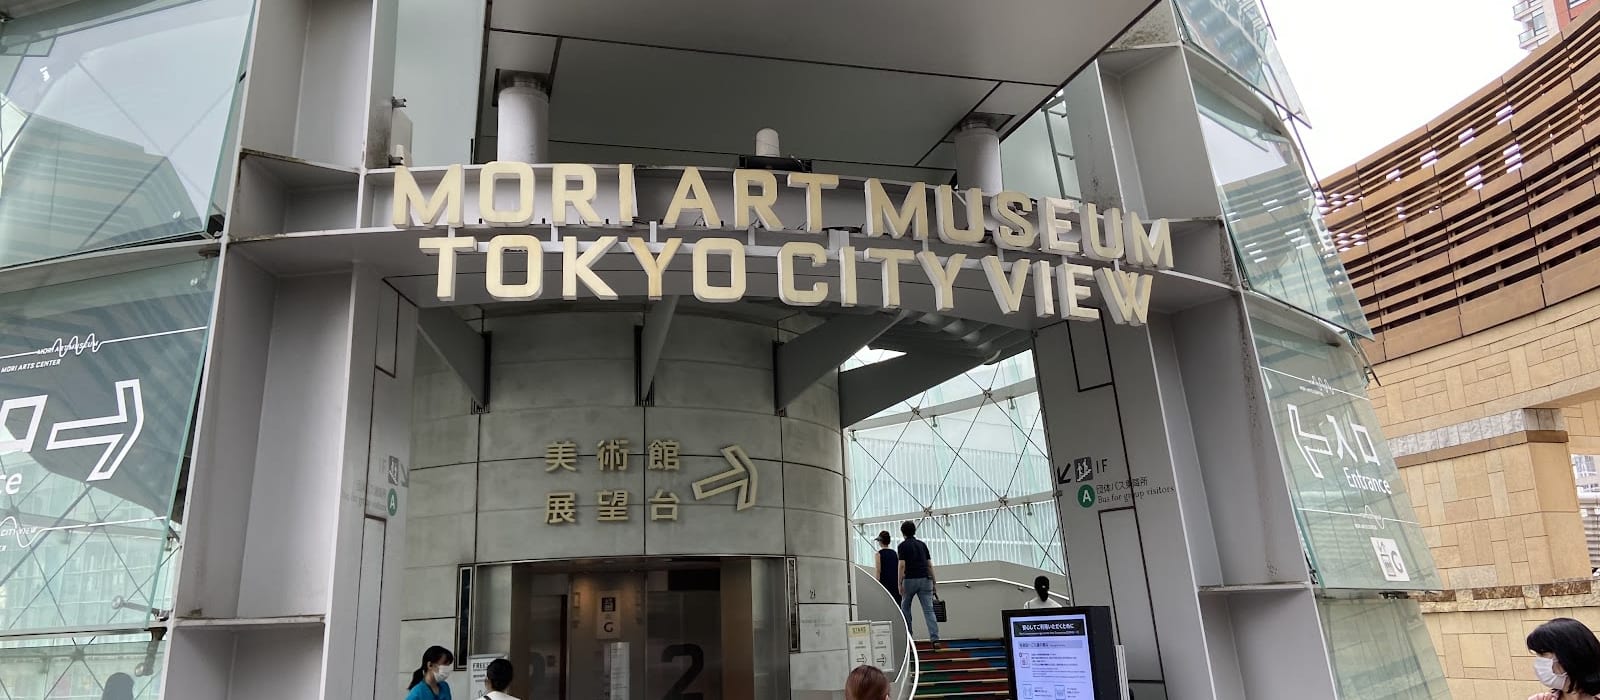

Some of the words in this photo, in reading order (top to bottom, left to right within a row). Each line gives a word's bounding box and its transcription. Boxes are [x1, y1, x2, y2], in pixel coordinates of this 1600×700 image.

[392, 161, 638, 229] MORI
[662, 166, 839, 232] ART
[864, 178, 1173, 269] MUSEUM
[418, 234, 746, 302] TOKYO
[777, 242, 966, 312] CITY
[981, 255, 1153, 326] VIEW
[1, 365, 18, 373] MORI
[18, 362, 35, 370] ARTS
[35, 359, 61, 369] CENTER
[544, 439, 681, 473] 美術館
[1326, 414, 1380, 466] 入口
[1111, 493, 1121, 501] for
[1343, 467, 1392, 494] Entrance
[544, 488, 681, 525] 展望台
[603, 622, 614, 633] G
